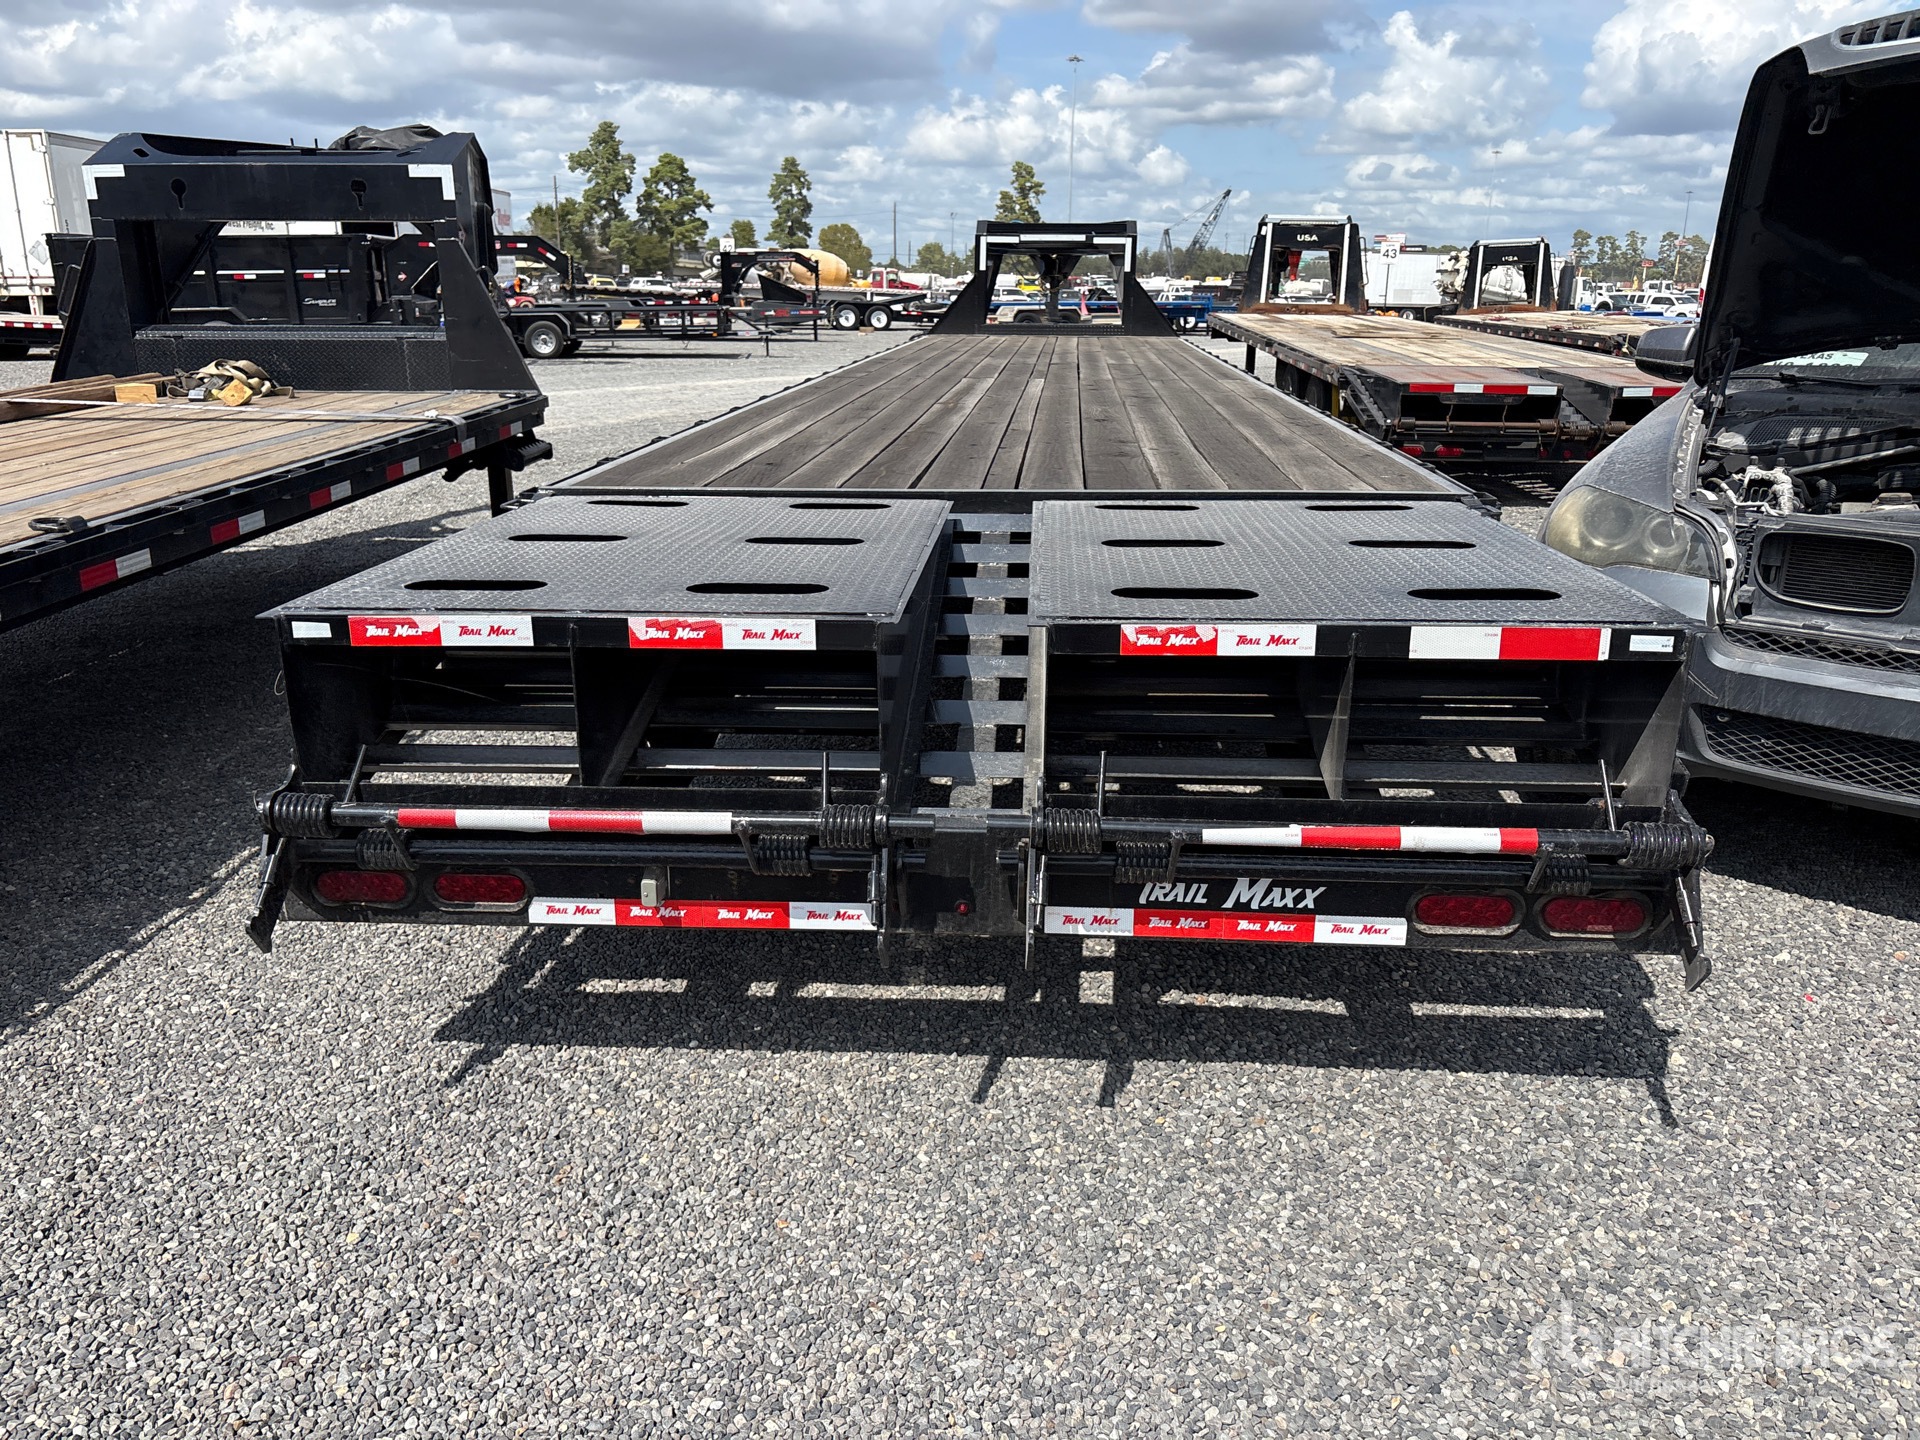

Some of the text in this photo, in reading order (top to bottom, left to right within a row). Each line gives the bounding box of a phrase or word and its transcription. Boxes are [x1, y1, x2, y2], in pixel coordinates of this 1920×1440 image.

[1382, 248, 1398, 259] 43
[365, 624, 423, 637] TRAIL MAXX
[458, 625, 518, 637] TRAIL MAXX
[646, 627, 707, 640] TRAIL MAXX
[741, 628, 802, 640] TRAIL MAXX
[1136, 633, 1200, 646] TRAIL MAXX
[1236, 635, 1300, 646] TRAIL MAXX
[1220, 877, 1328, 910] MAXX
[545, 905, 602, 915] TRAIL MAXX
[629, 906, 688, 918] TRAIL MAXX
[717, 908, 774, 920] TRAIL MAXX
[806, 910, 863, 921] TRAIL MAXX
[1062, 915, 1120, 926] TRAIL MAXX
[1148, 917, 1208, 928] TRAIL MAXX
[1236, 919, 1297, 932] TRAIL MAXX
[1330, 923, 1390, 935] TRAIL MAXX
